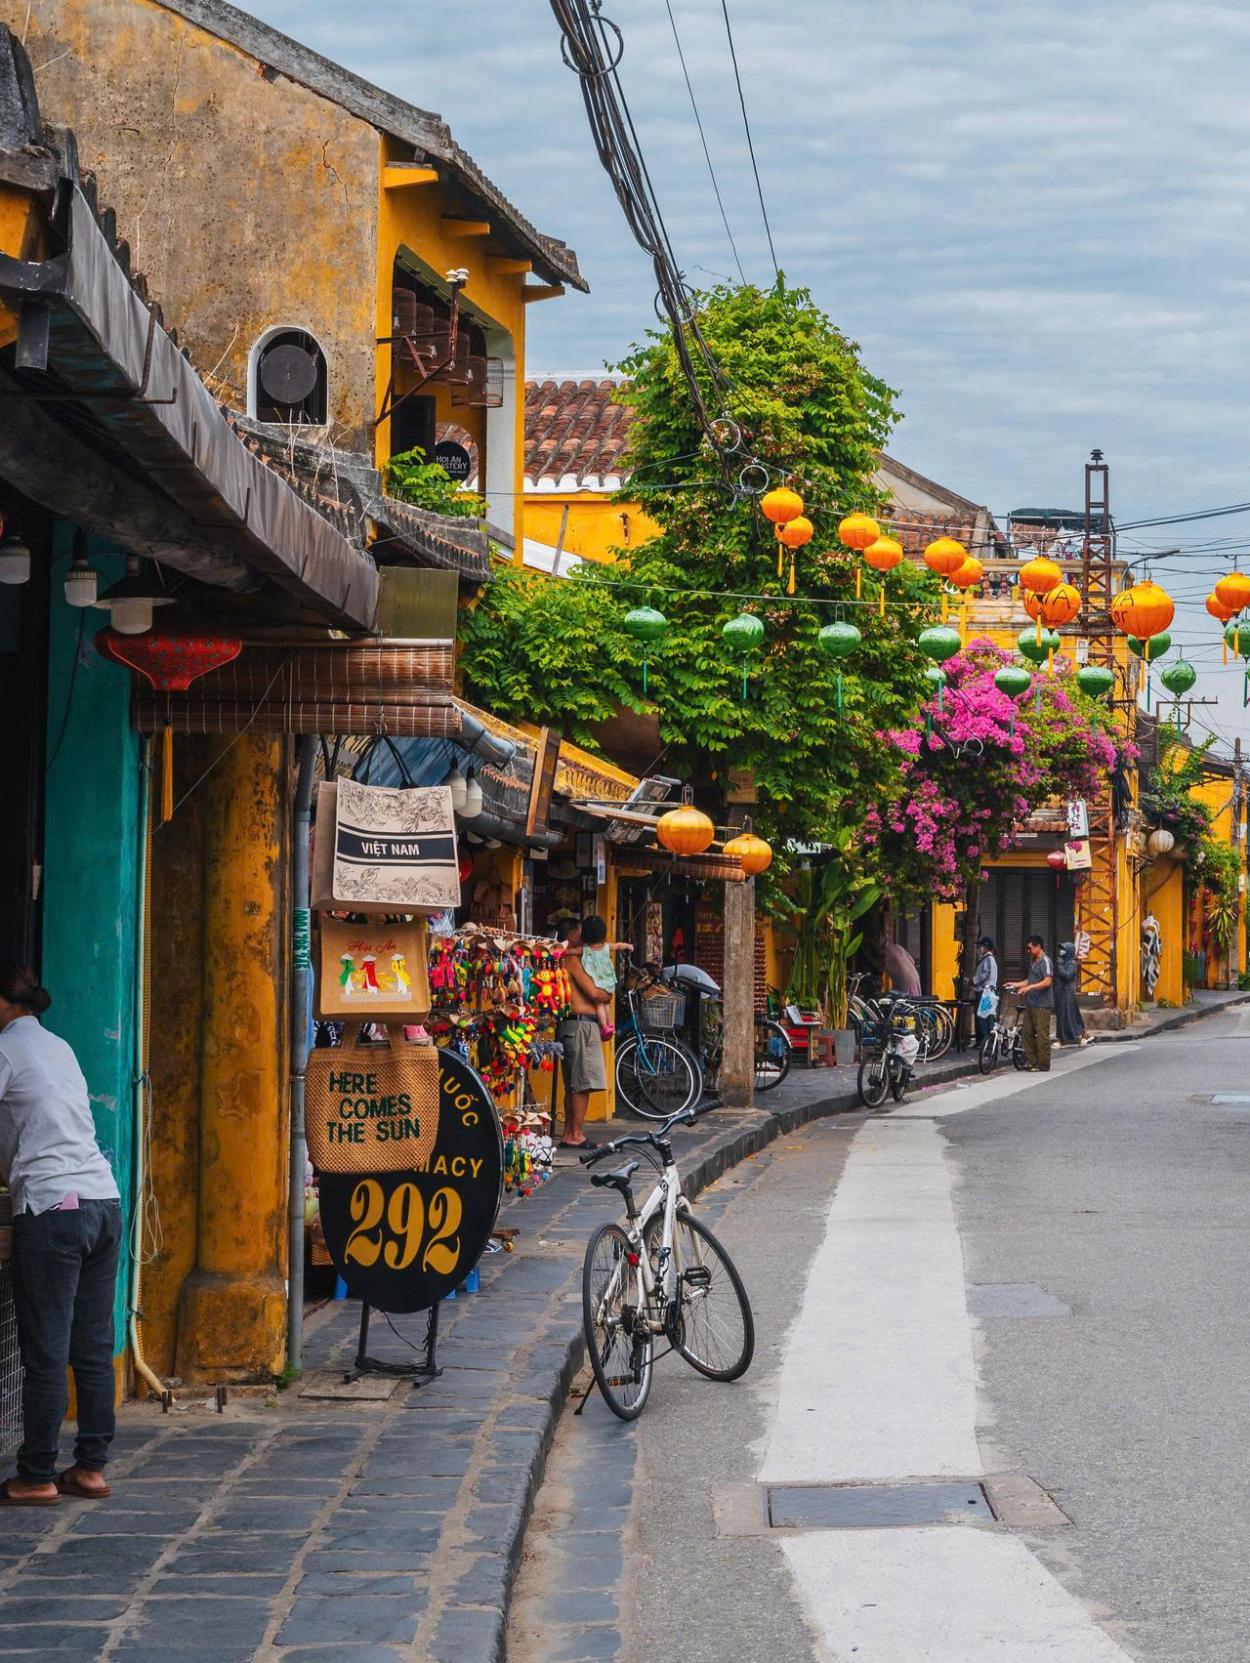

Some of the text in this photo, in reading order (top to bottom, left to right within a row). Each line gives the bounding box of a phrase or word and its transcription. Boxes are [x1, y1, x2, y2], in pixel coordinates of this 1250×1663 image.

[361, 840, 420, 857] VIỆT NAM
[329, 1070, 377, 1094] HERE
[339, 1093, 412, 1119] COMES
[327, 1118, 420, 1143] THE SUN
[344, 1178, 463, 1276] 292
